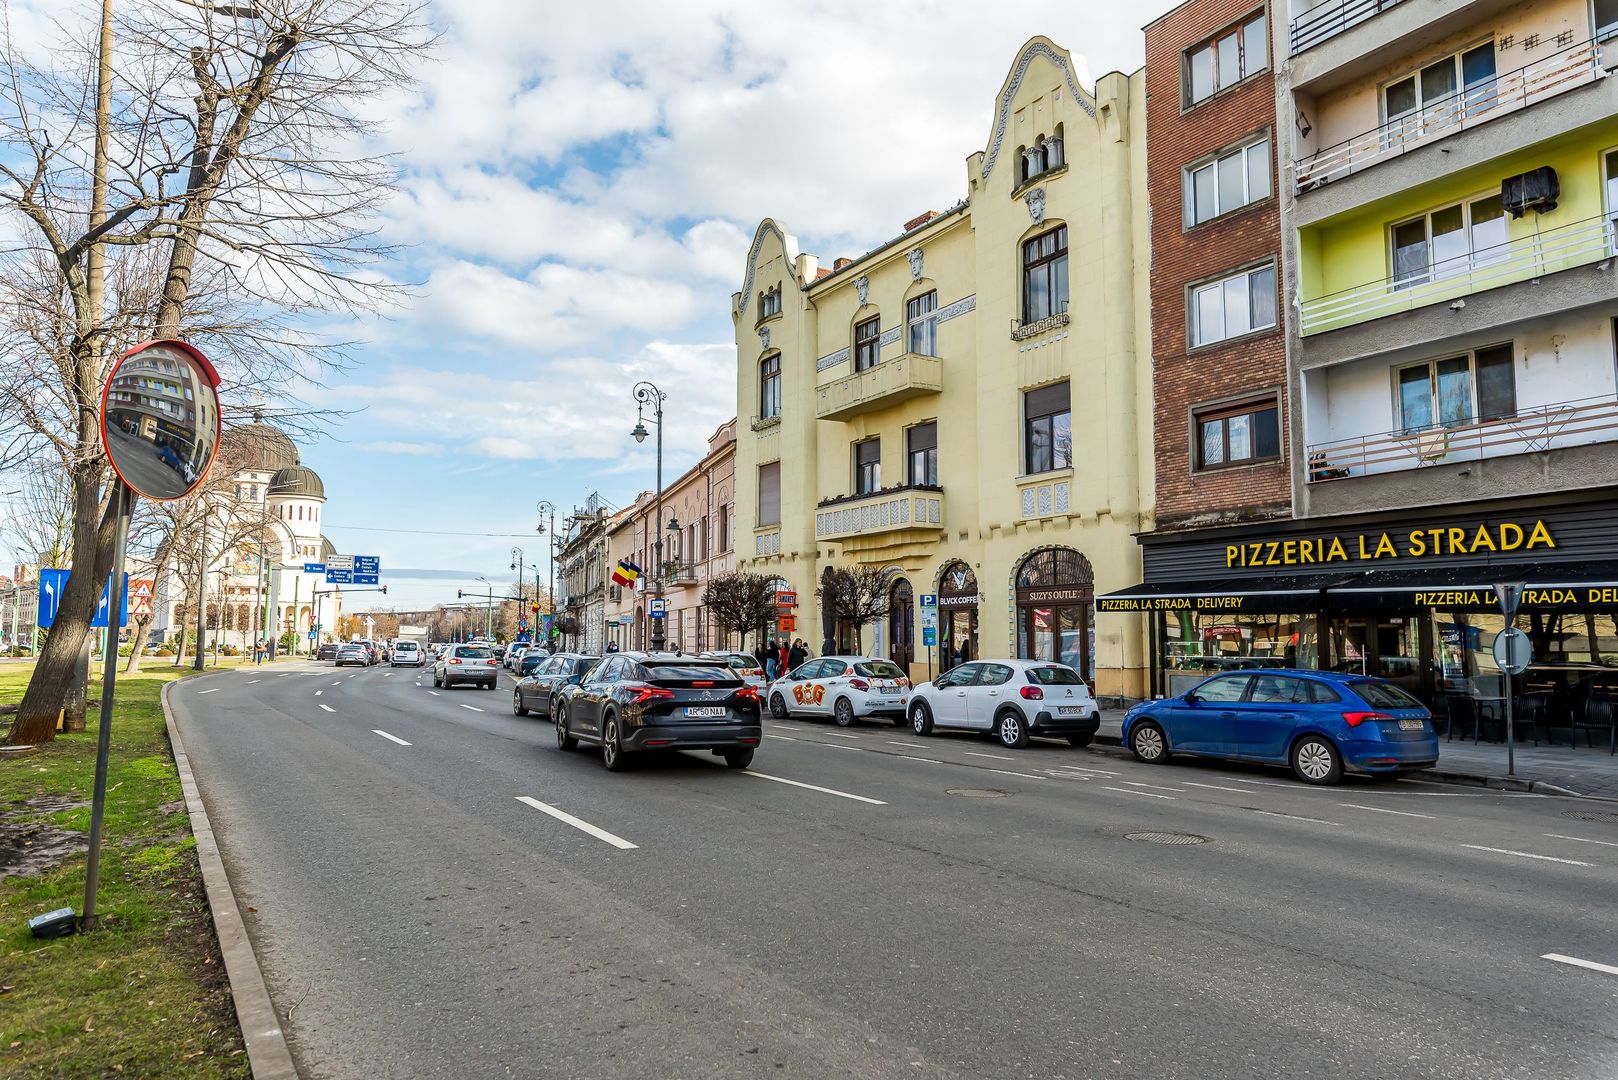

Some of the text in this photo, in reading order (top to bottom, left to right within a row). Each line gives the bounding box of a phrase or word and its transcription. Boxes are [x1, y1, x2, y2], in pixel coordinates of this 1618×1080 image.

[1226, 519, 1556, 568] PIZZERIA LA STRADA
[924, 595, 933, 606] P
[939, 597, 958, 605] BLVCK
[1029, 591, 1053, 600] SUZY'S
[1415, 591, 1480, 606] PIZZERIA
[1521, 589, 1577, 604] TRADA
[1101, 597, 1244, 610] PIZZERIA LA STRADA DELIVERY
[689, 708, 698, 716] AR
[710, 708, 724, 716] NAA
